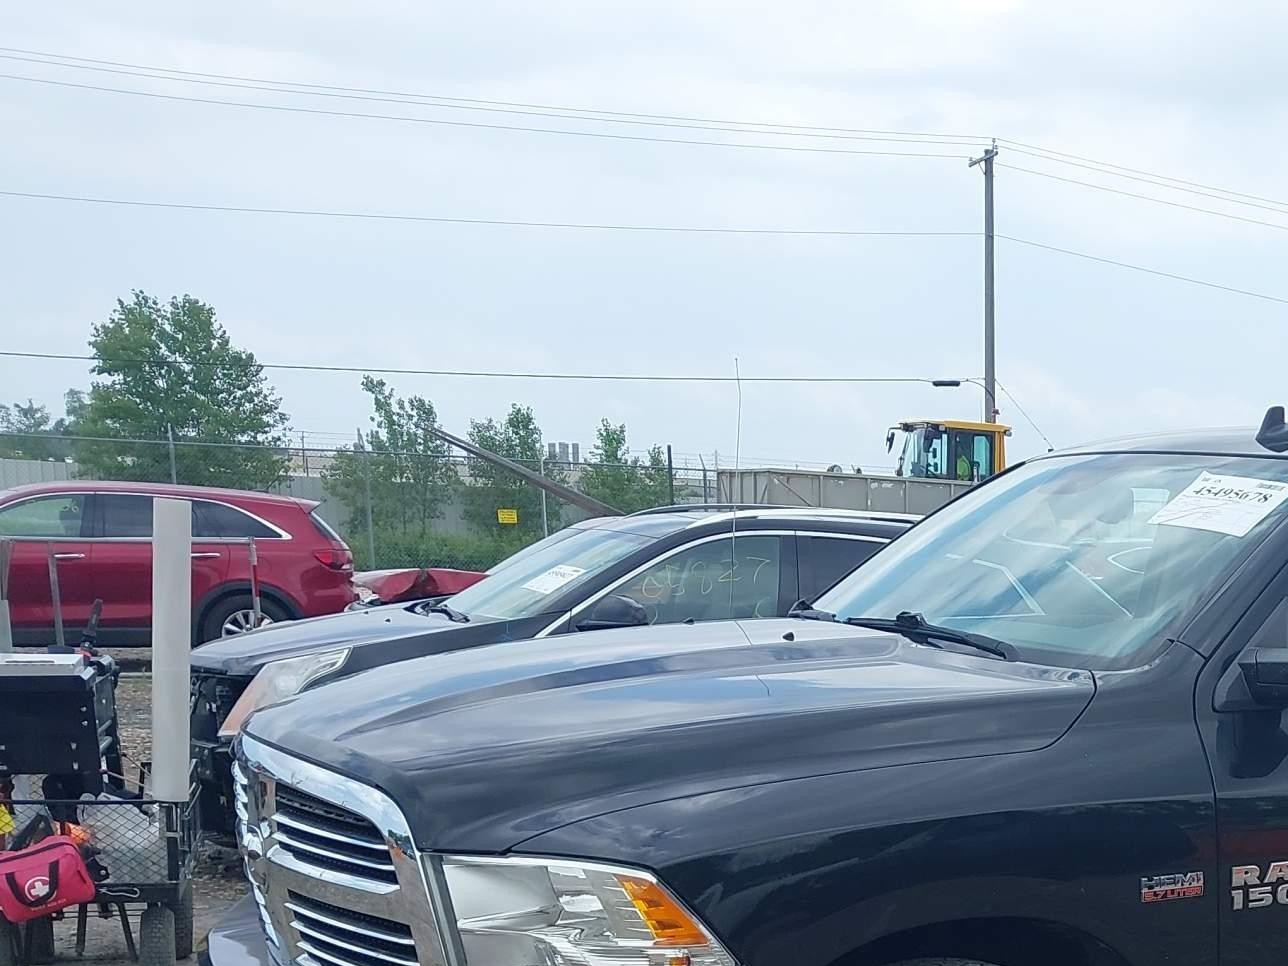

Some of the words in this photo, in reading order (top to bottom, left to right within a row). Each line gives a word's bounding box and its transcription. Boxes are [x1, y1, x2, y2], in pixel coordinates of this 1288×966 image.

[1193, 486, 1273, 503] 45495678
[1140, 871, 1204, 890] HEMI
[1143, 889, 1165, 901] 5.7
[1166, 886, 1202, 898] LITER
